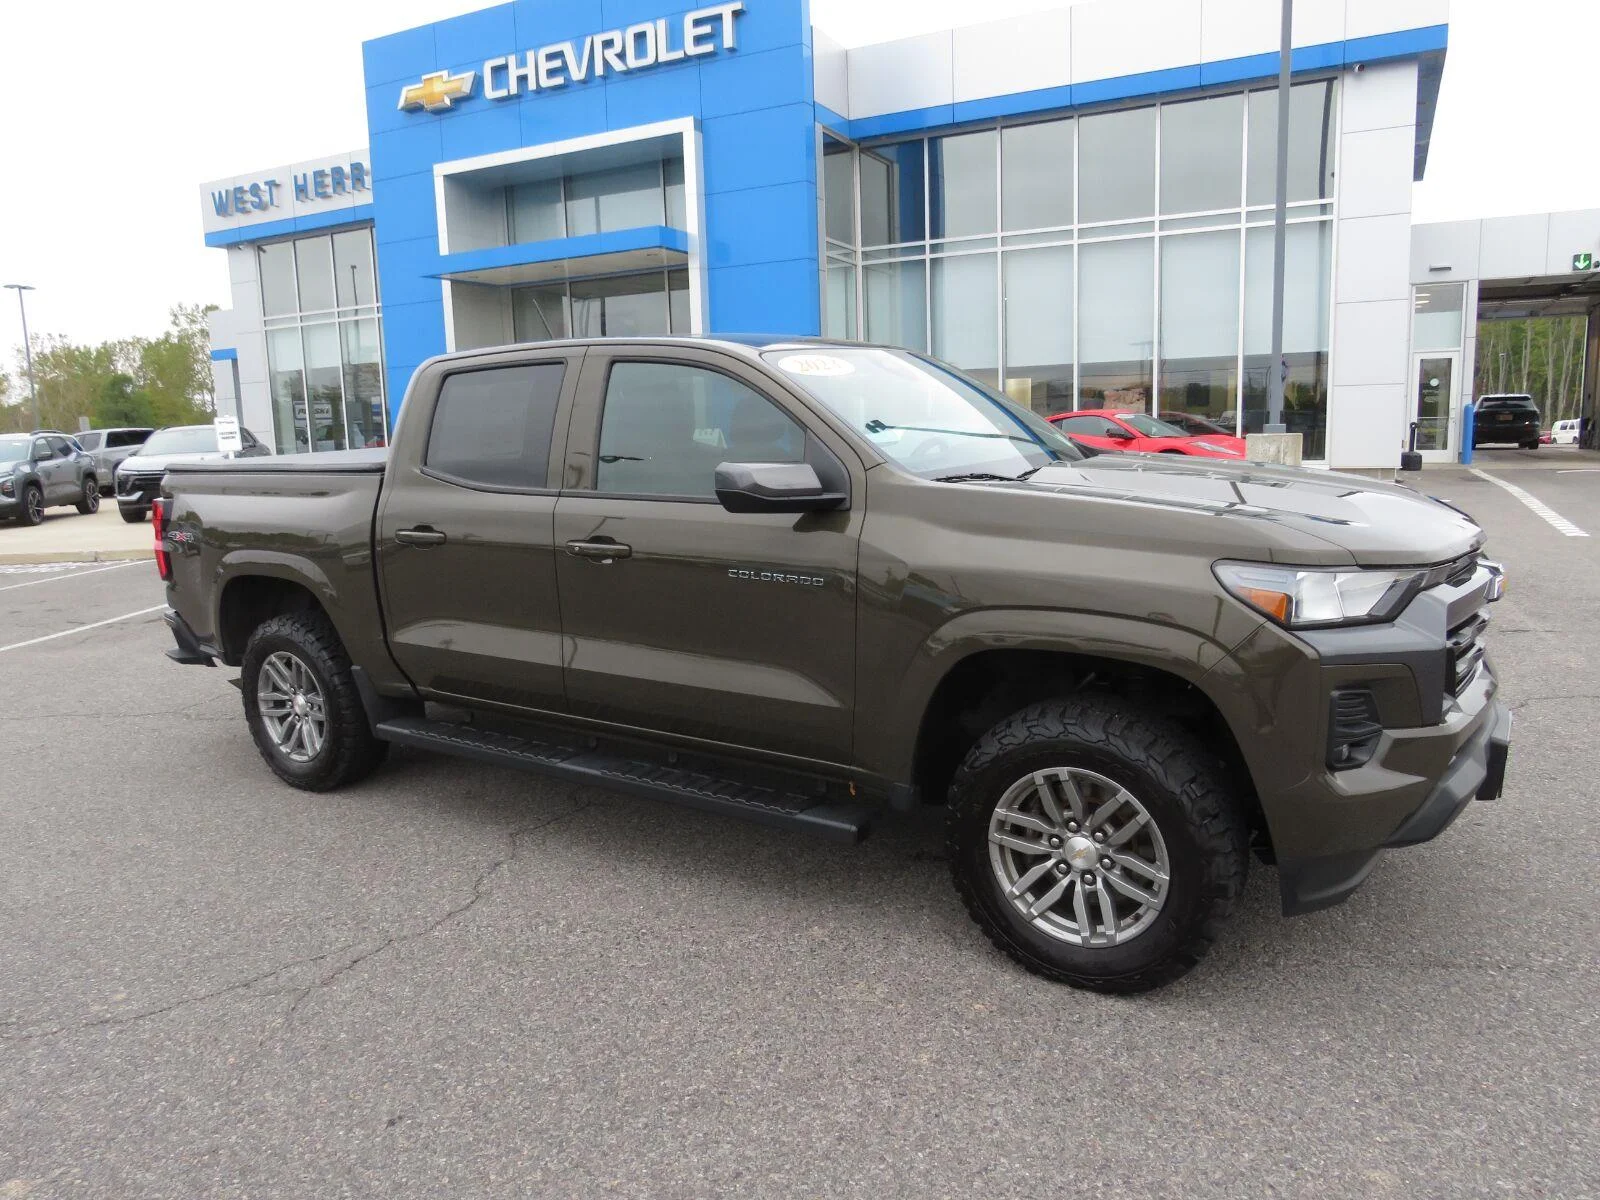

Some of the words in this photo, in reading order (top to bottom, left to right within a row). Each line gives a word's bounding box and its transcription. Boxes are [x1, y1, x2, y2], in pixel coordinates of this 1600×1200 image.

[483, 1, 745, 100] CHEVROLET
[211, 179, 279, 218] WEST
[294, 162, 367, 201] HERR
[728, 569, 824, 586] COLORADO
